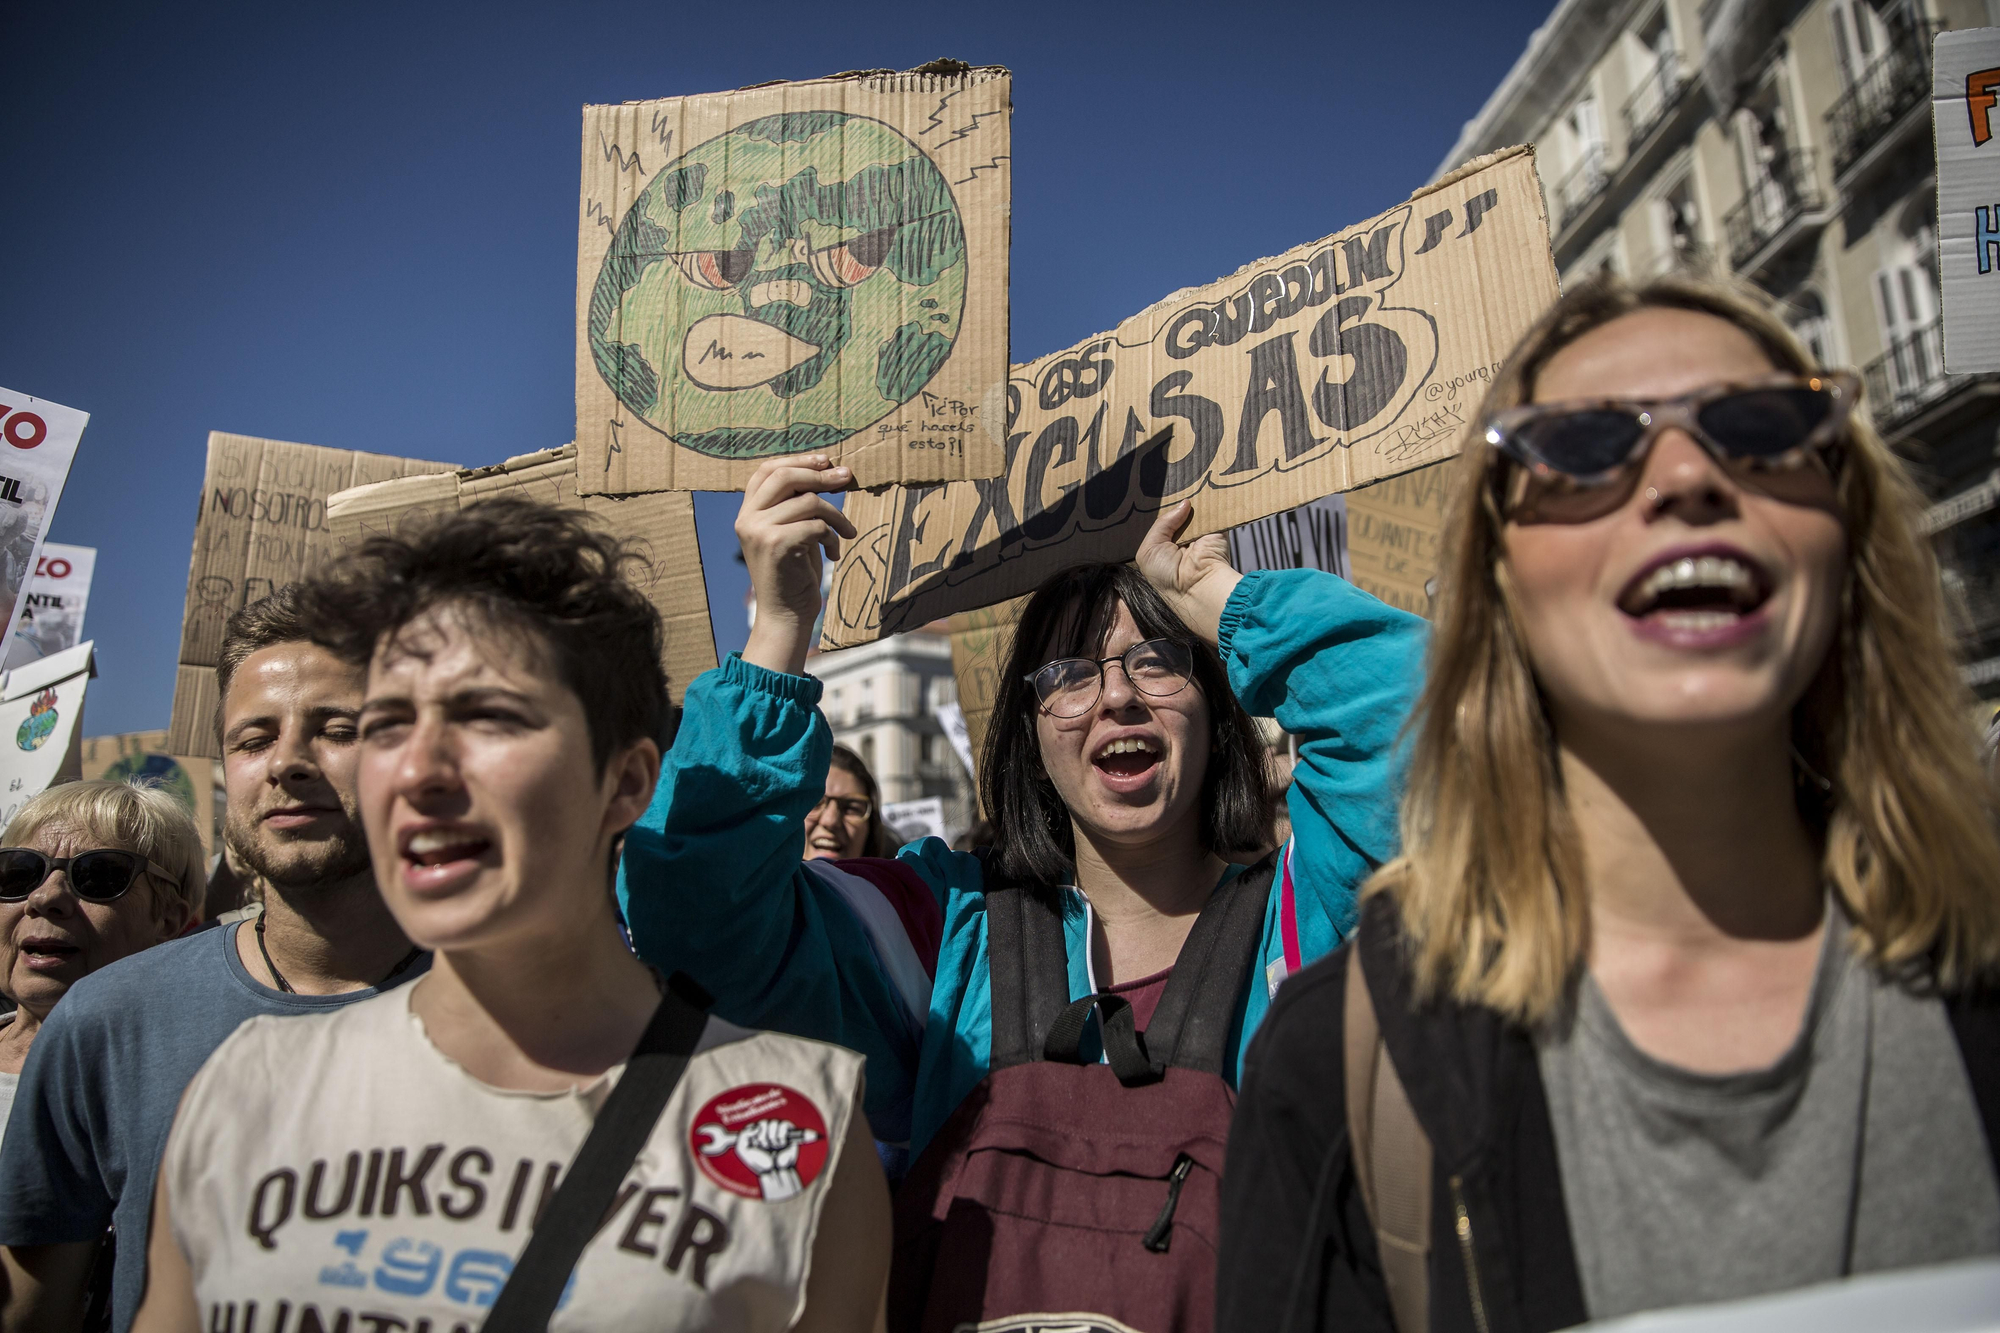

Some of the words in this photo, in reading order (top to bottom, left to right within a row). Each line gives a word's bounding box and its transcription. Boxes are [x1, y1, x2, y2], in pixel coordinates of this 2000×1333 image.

[878, 420, 912, 440] qué
[884, 296, 1407, 604] EXCUSAS
[909, 436, 963, 458] esto?!
[318, 1229, 577, 1312] 196
